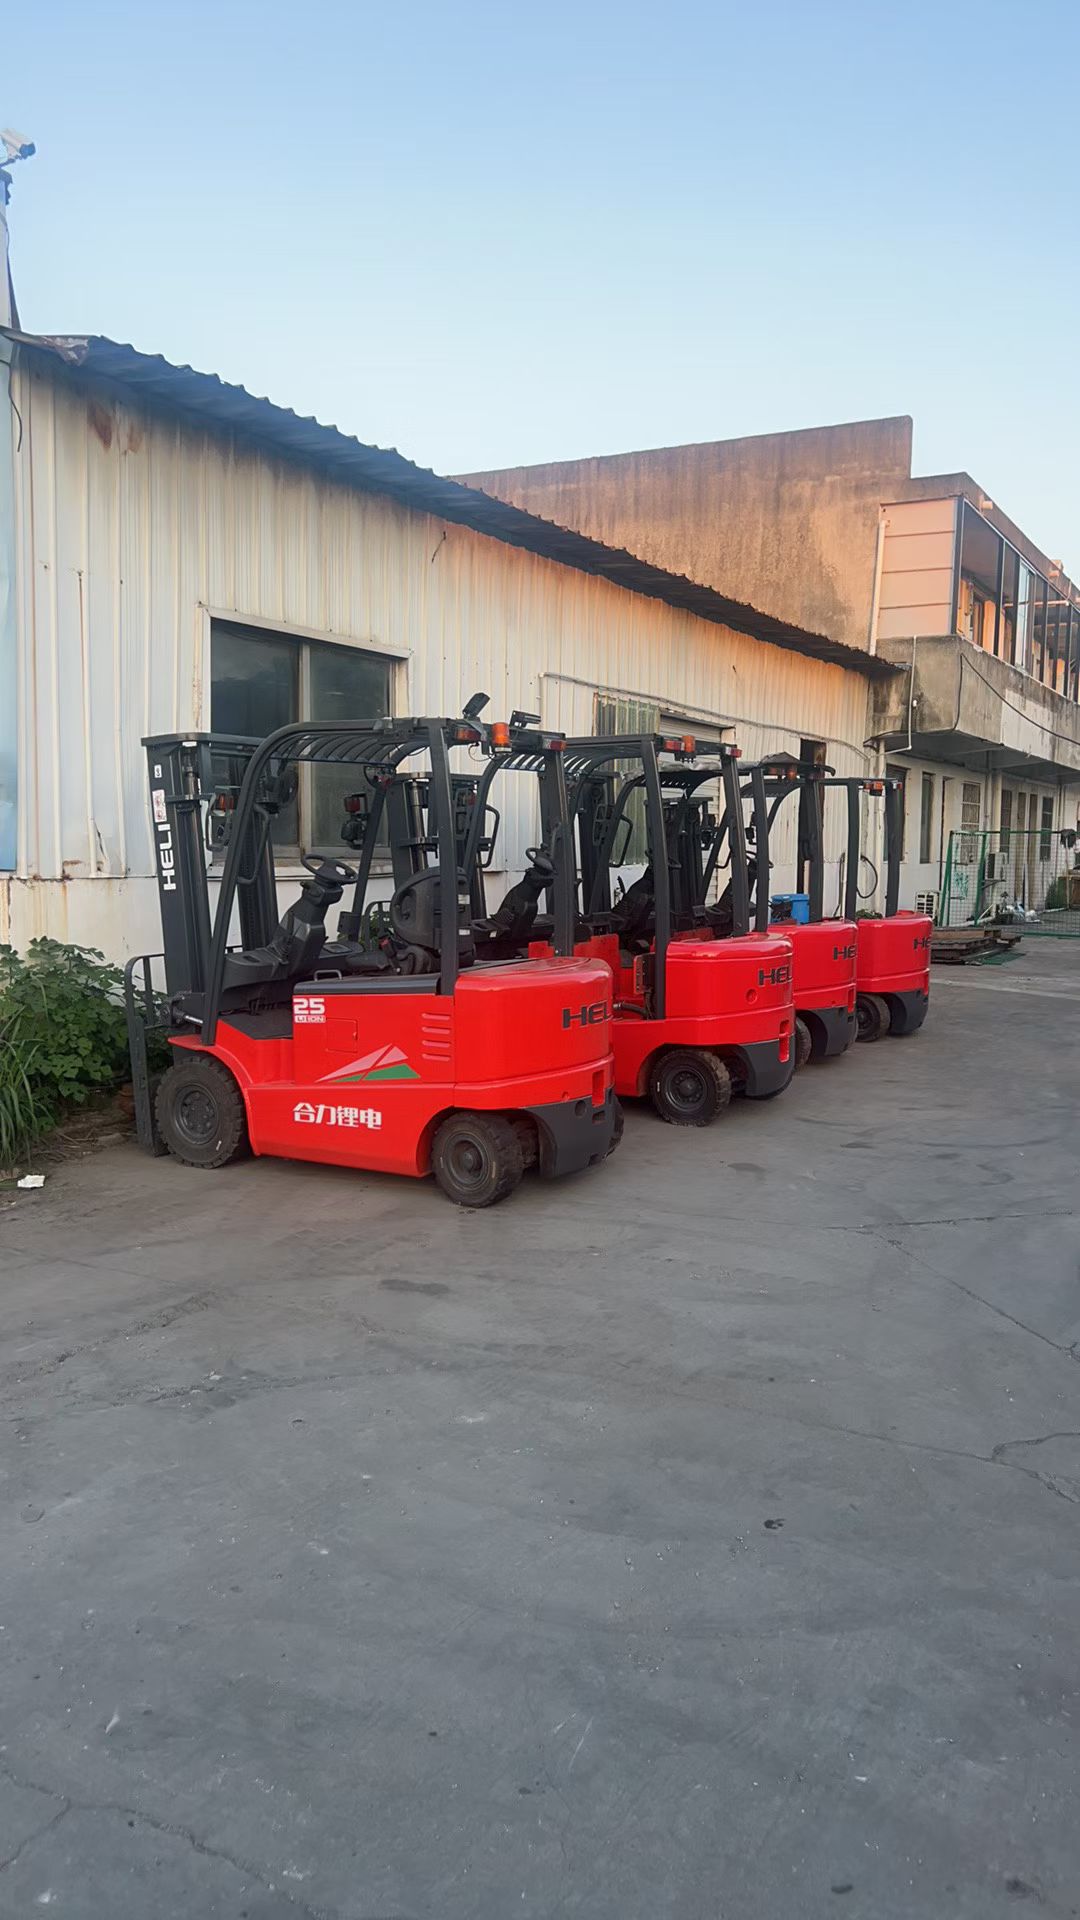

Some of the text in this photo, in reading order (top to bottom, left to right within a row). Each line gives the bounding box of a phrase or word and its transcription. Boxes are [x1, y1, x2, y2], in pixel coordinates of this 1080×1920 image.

[157, 823, 177, 890] HELI
[832, 946, 858, 961] HE
[758, 967, 793, 986] HEL
[293, 998, 325, 1014] 25
[562, 1000, 609, 1029] HEL
[293, 1102, 382, 1130] 合力锂电
